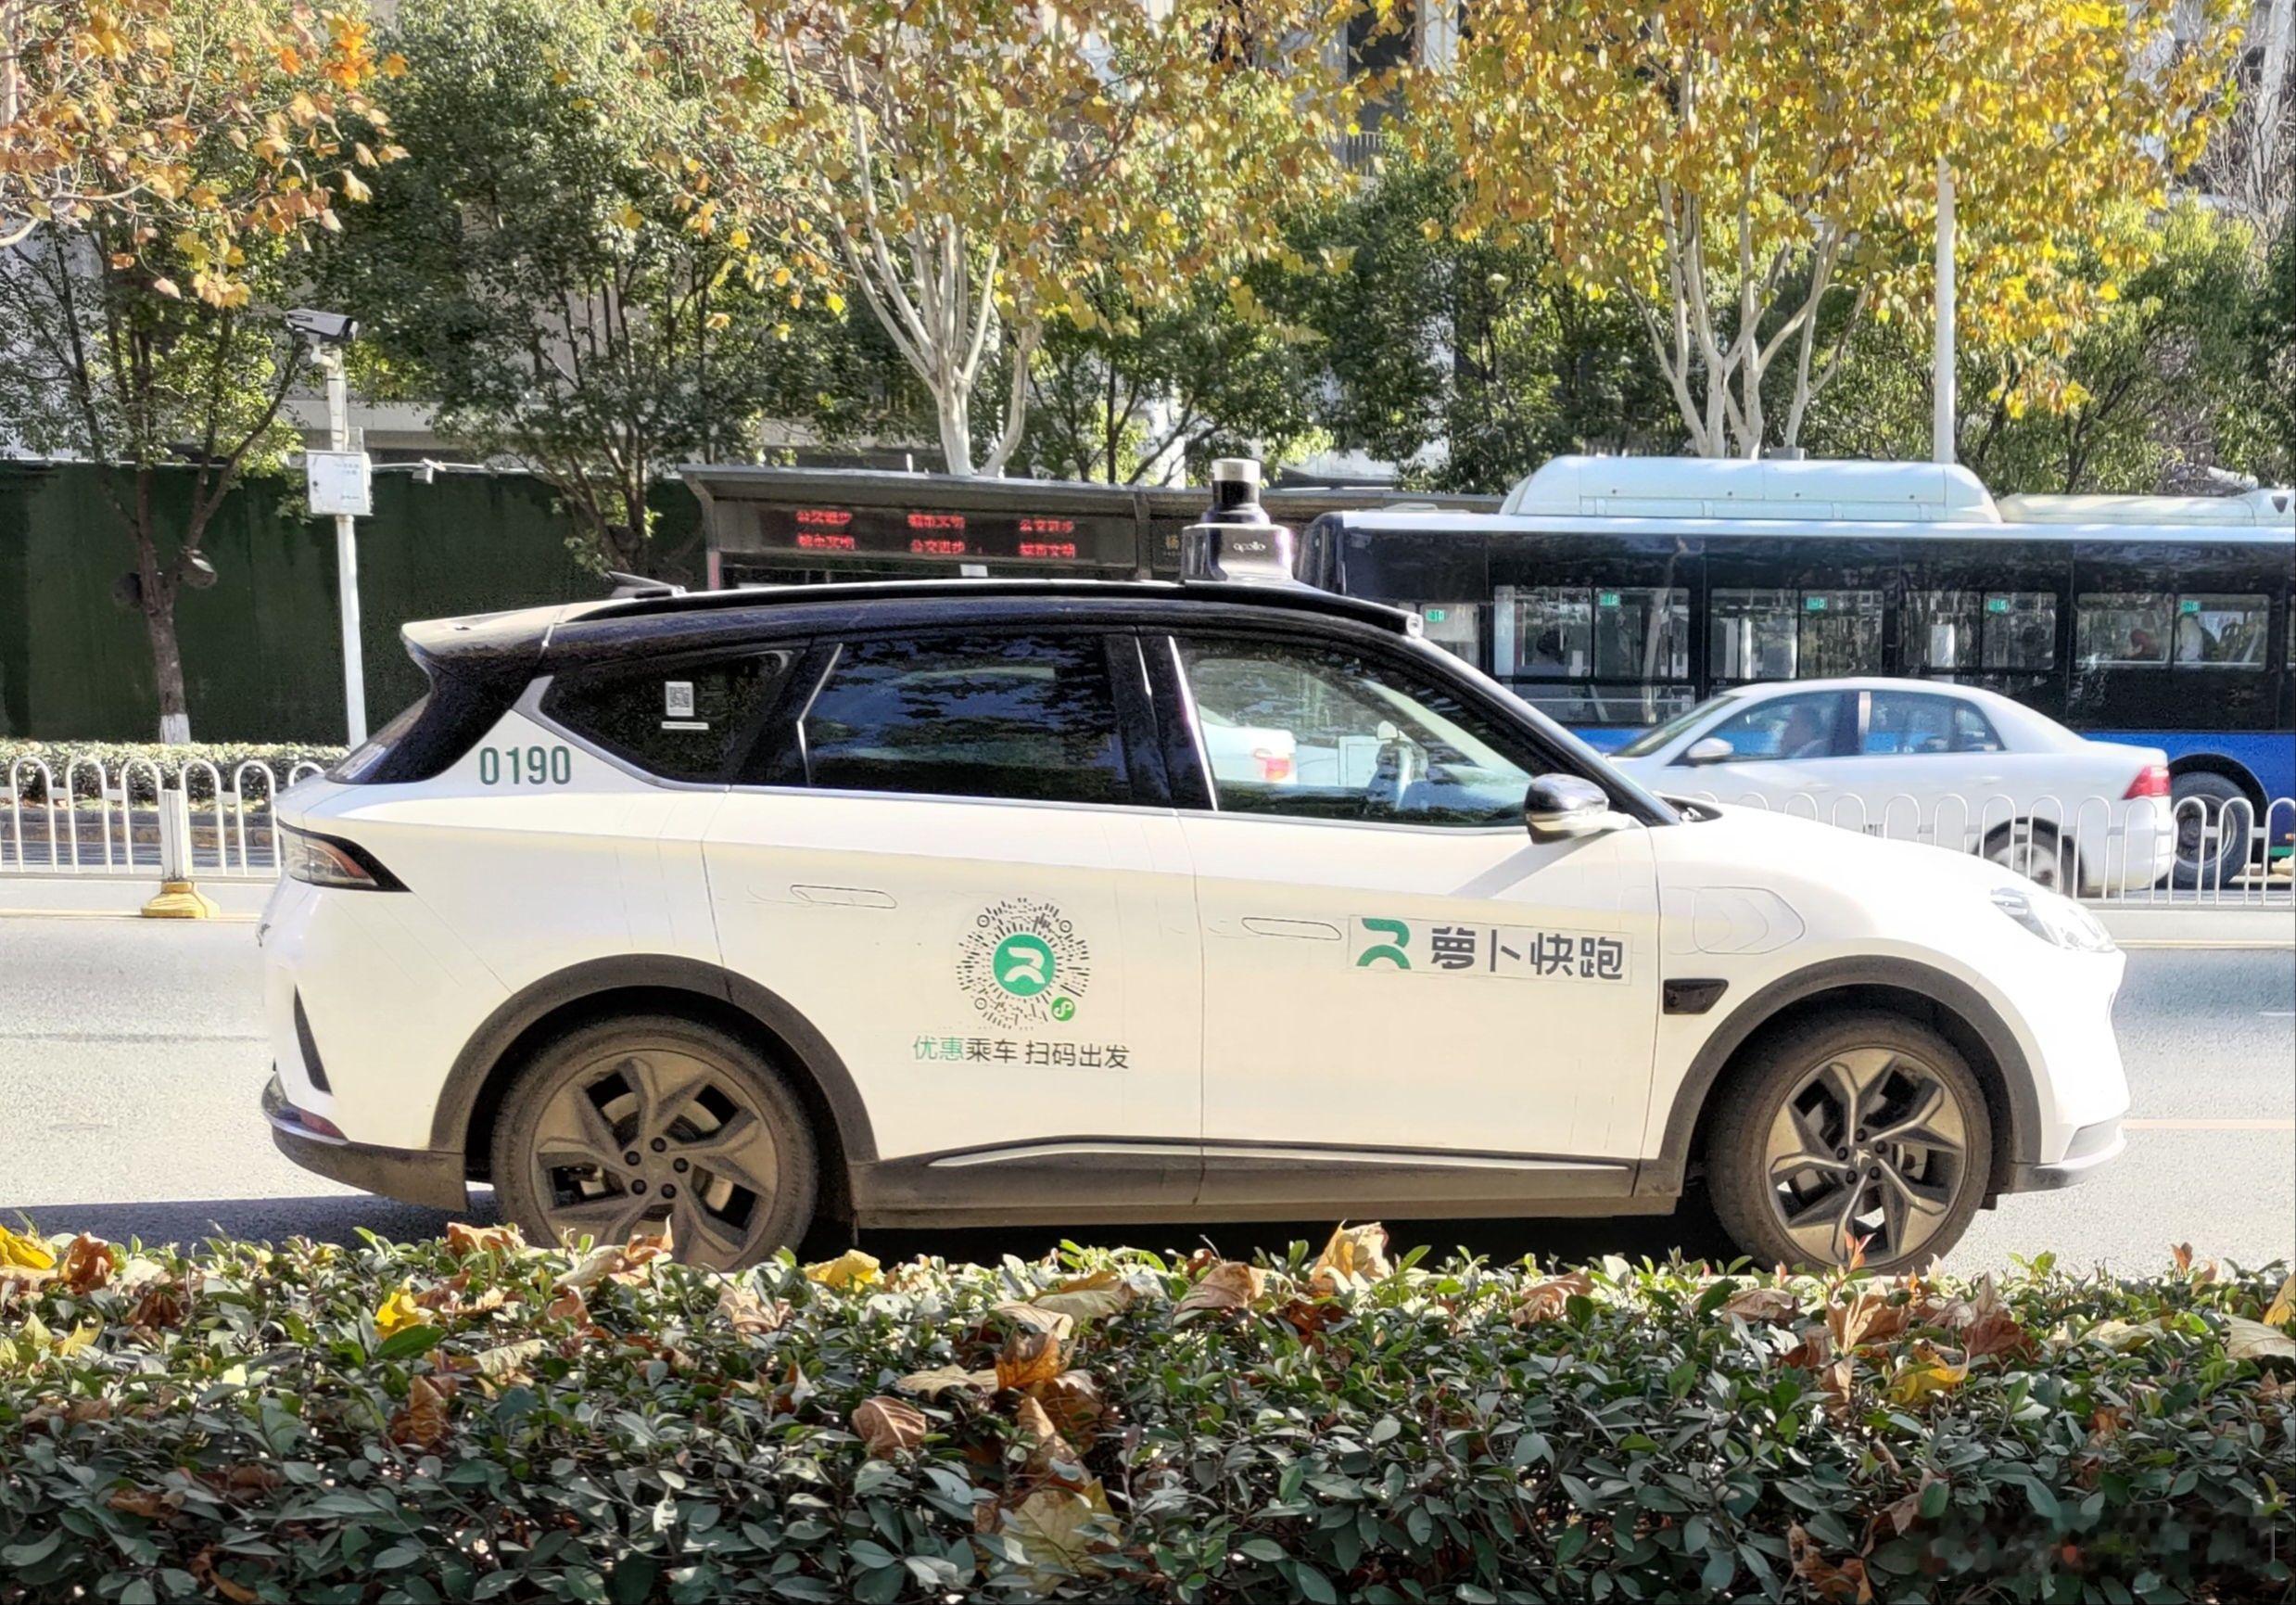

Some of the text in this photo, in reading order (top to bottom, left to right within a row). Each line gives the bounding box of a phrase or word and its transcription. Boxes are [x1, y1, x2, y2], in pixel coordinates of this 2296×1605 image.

[1233, 541, 1266, 554] apollo
[479, 745, 571, 785] 0190
[1430, 925, 1623, 980] 萝卜快跑
[912, 1035, 1130, 1069] 优惠乘车 扫码出发
